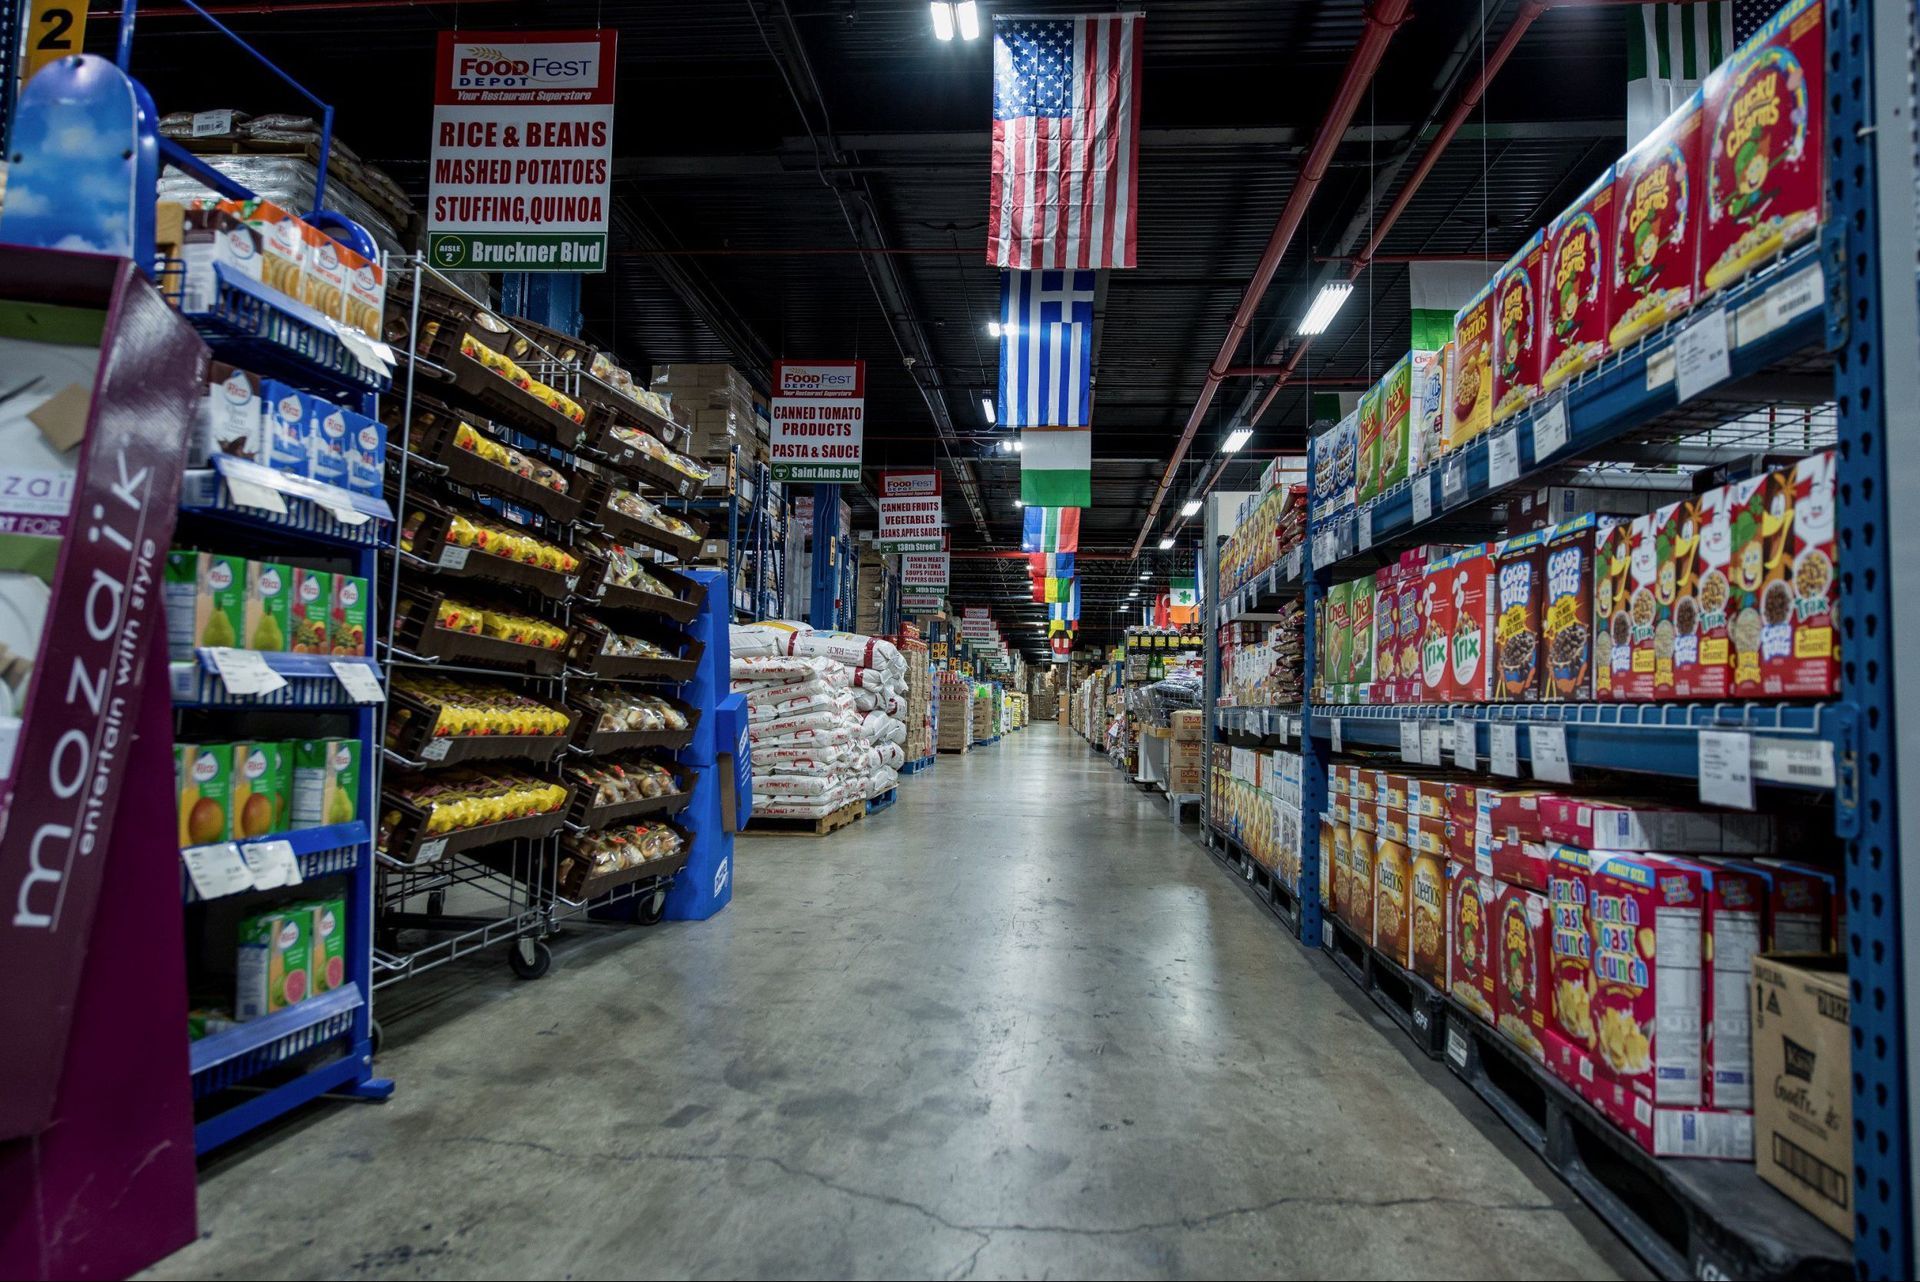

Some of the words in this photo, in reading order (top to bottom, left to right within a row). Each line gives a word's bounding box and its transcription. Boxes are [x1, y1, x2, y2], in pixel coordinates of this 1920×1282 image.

[36, 8, 73, 50] 2
[460, 77, 528, 86] DEPOT
[457, 91, 480, 100] Your
[481, 91, 536, 100] Restaurant
[537, 91, 592, 102] Superstore
[440, 122, 498, 147] RICE
[502, 126, 520, 148] &
[526, 121, 607, 148] BEANS
[435, 159, 512, 184] MASHED
[515, 159, 606, 184] POTATOES
[445, 253, 453, 262] 2
[472, 241, 558, 262] Bruckner
[560, 242, 600, 262] Blvd
[774, 406, 816, 420] CANNED
[818, 406, 862, 420] TOMATO
[782, 422, 852, 436] PRODUCTS
[772, 444, 808, 458] PASTA
[811, 446, 819, 458] &
[822, 444, 860, 458] SAUCE
[792, 466, 816, 478] Saint
[818, 468, 840, 478] Anns
[842, 468, 858, 478] Ave
[882, 503, 910, 512] CANNED
[912, 502, 939, 512] FRUITS
[18, 517, 62, 535] FOR
[885, 514, 936, 525] VEGETABLES
[920, 528, 940, 536] SAUCE
[916, 543, 936, 551] Street
[1548, 549, 1580, 578] Cocoa
[1501, 562, 1530, 589] Cocoa
[1423, 632, 1446, 672] Trix
[1453, 624, 1479, 669] Trix
[78, 696, 125, 857] entertain
[116, 618, 141, 688] with
[133, 538, 157, 612] style
[1590, 890, 1640, 926] French
[1597, 922, 1636, 956] Toast
[1594, 948, 1649, 988] Crunch
